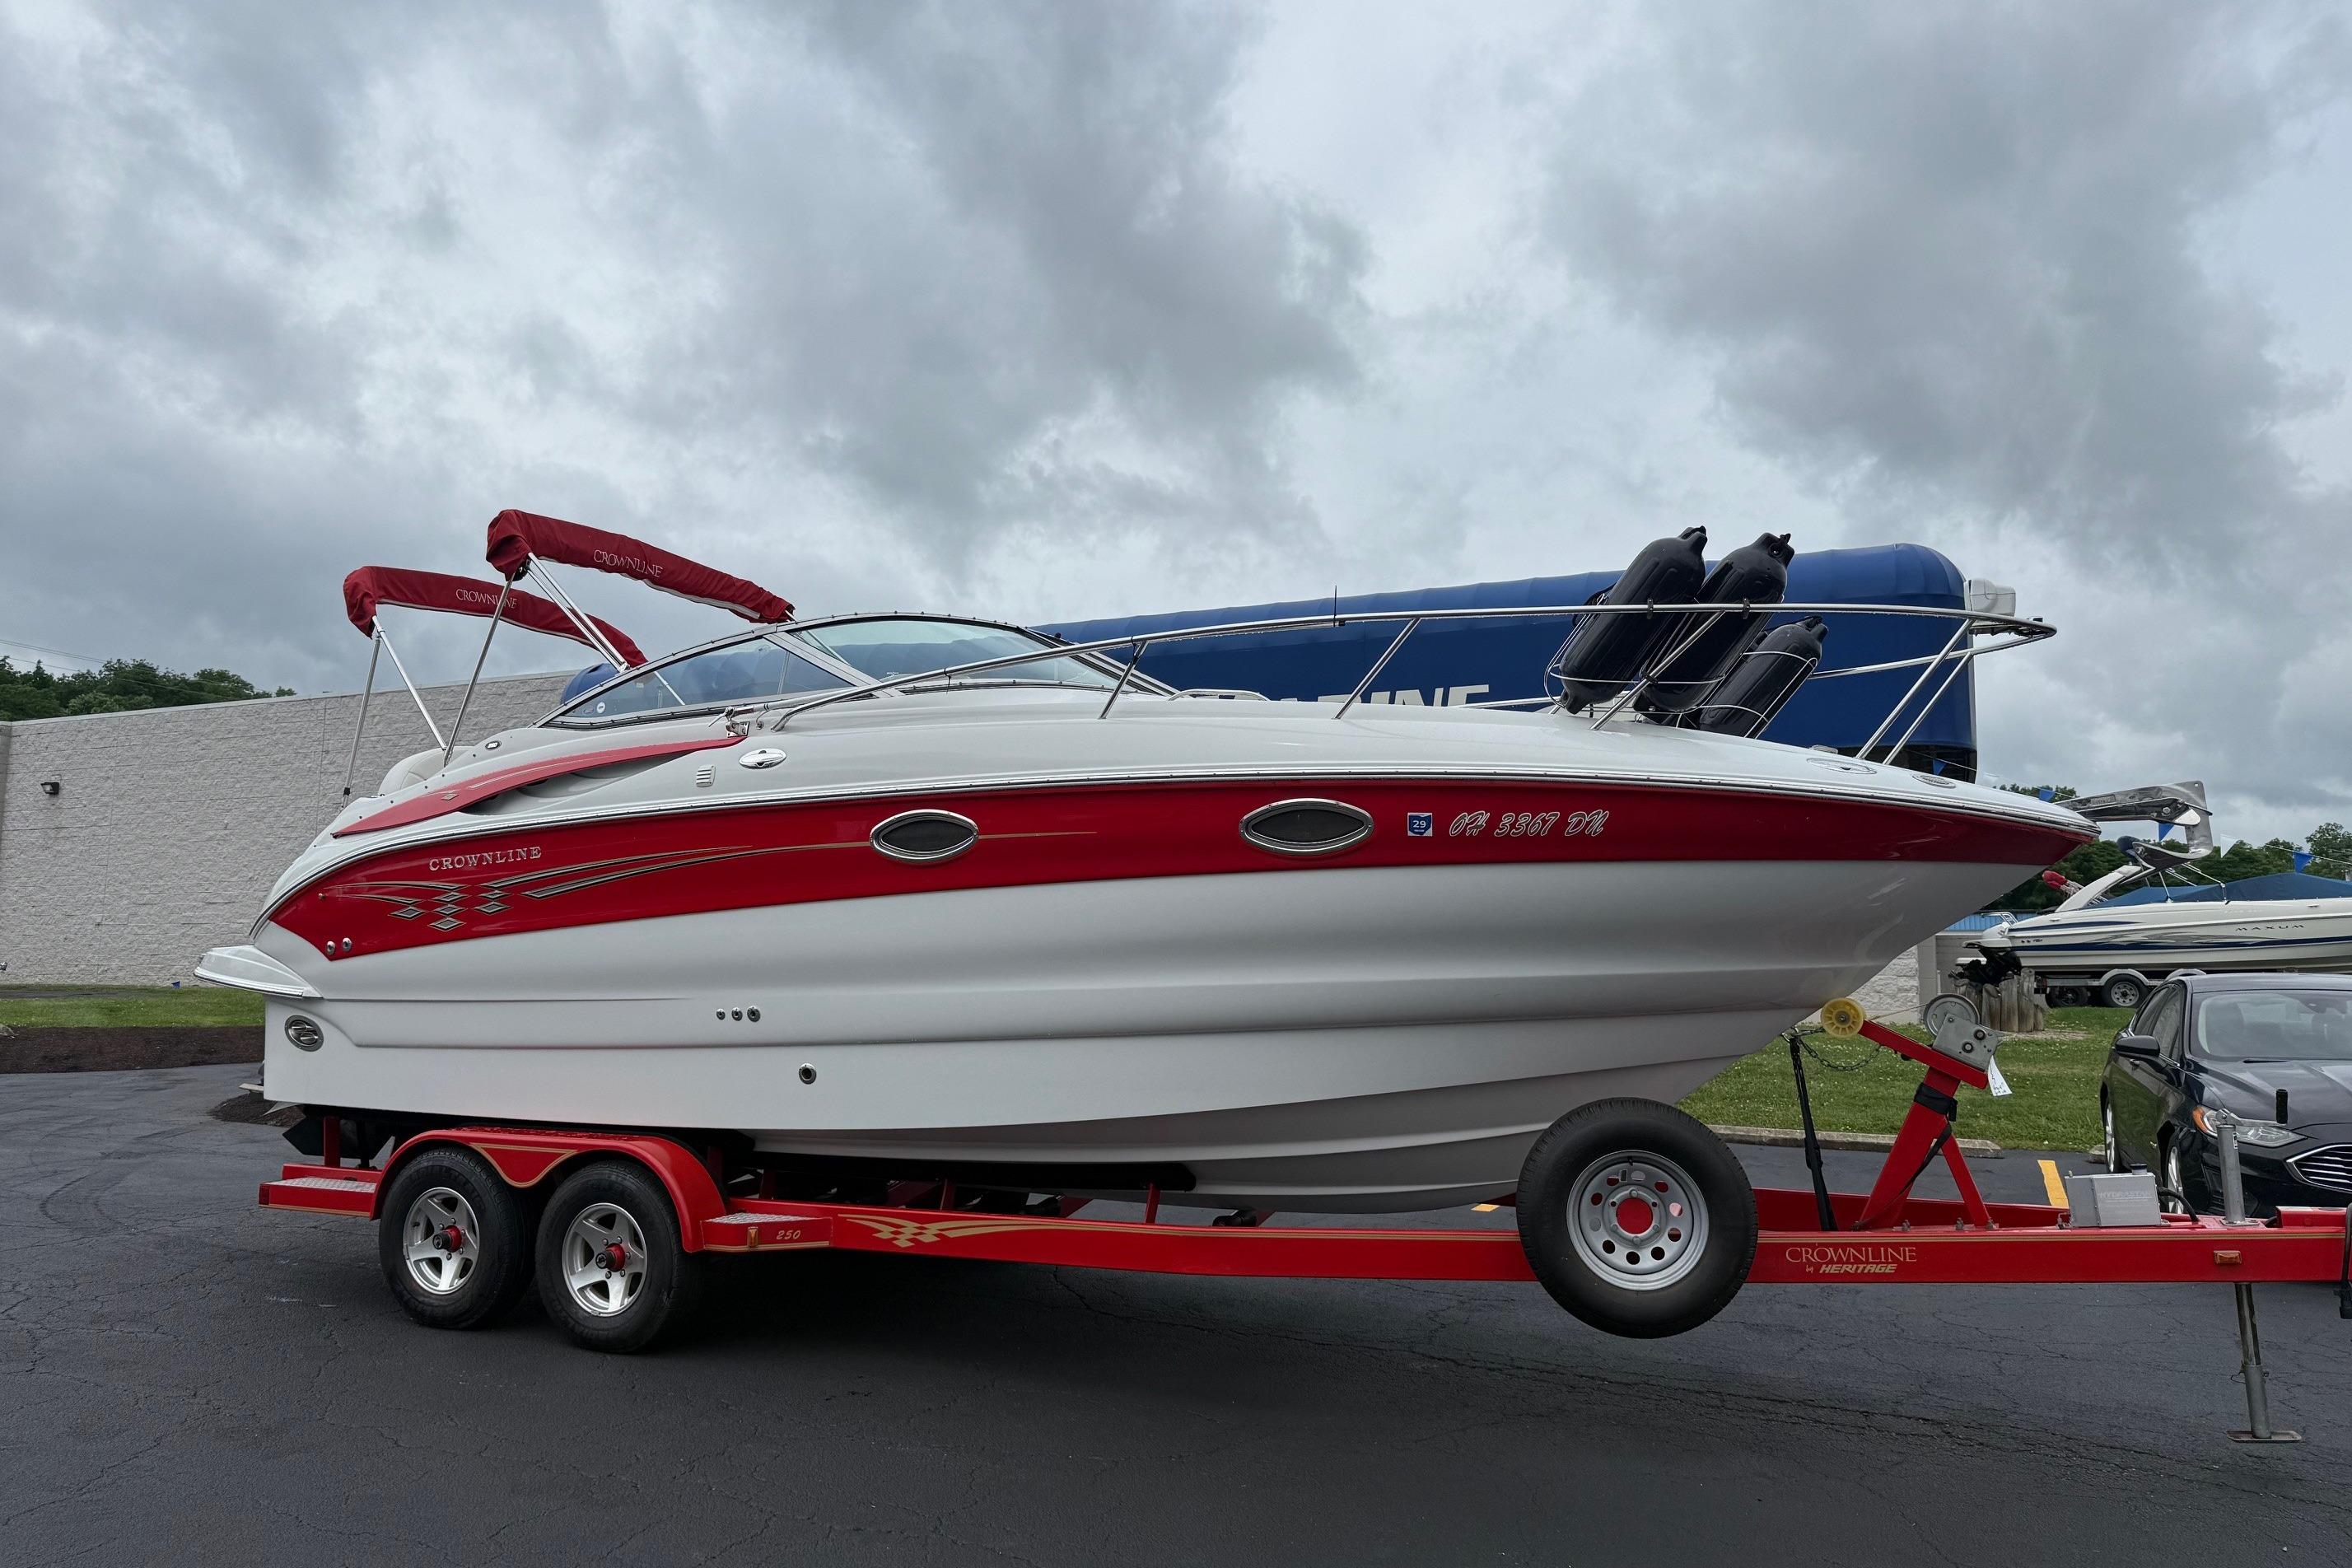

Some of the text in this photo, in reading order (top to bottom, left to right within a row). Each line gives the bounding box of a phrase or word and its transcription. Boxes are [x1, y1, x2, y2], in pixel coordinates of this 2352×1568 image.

[594, 549, 664, 578] CROWNLINE
[455, 589, 518, 609] CROWNLNE
[1412, 819, 1426, 828] 29
[1449, 810, 1609, 838] OH 3367 DN
[429, 847, 542, 870] CROWNLINE
[776, 1230, 801, 1240] 250
[1785, 1247, 1917, 1262] CROWNLINE
[1818, 1263, 1898, 1274] HERITAGE
